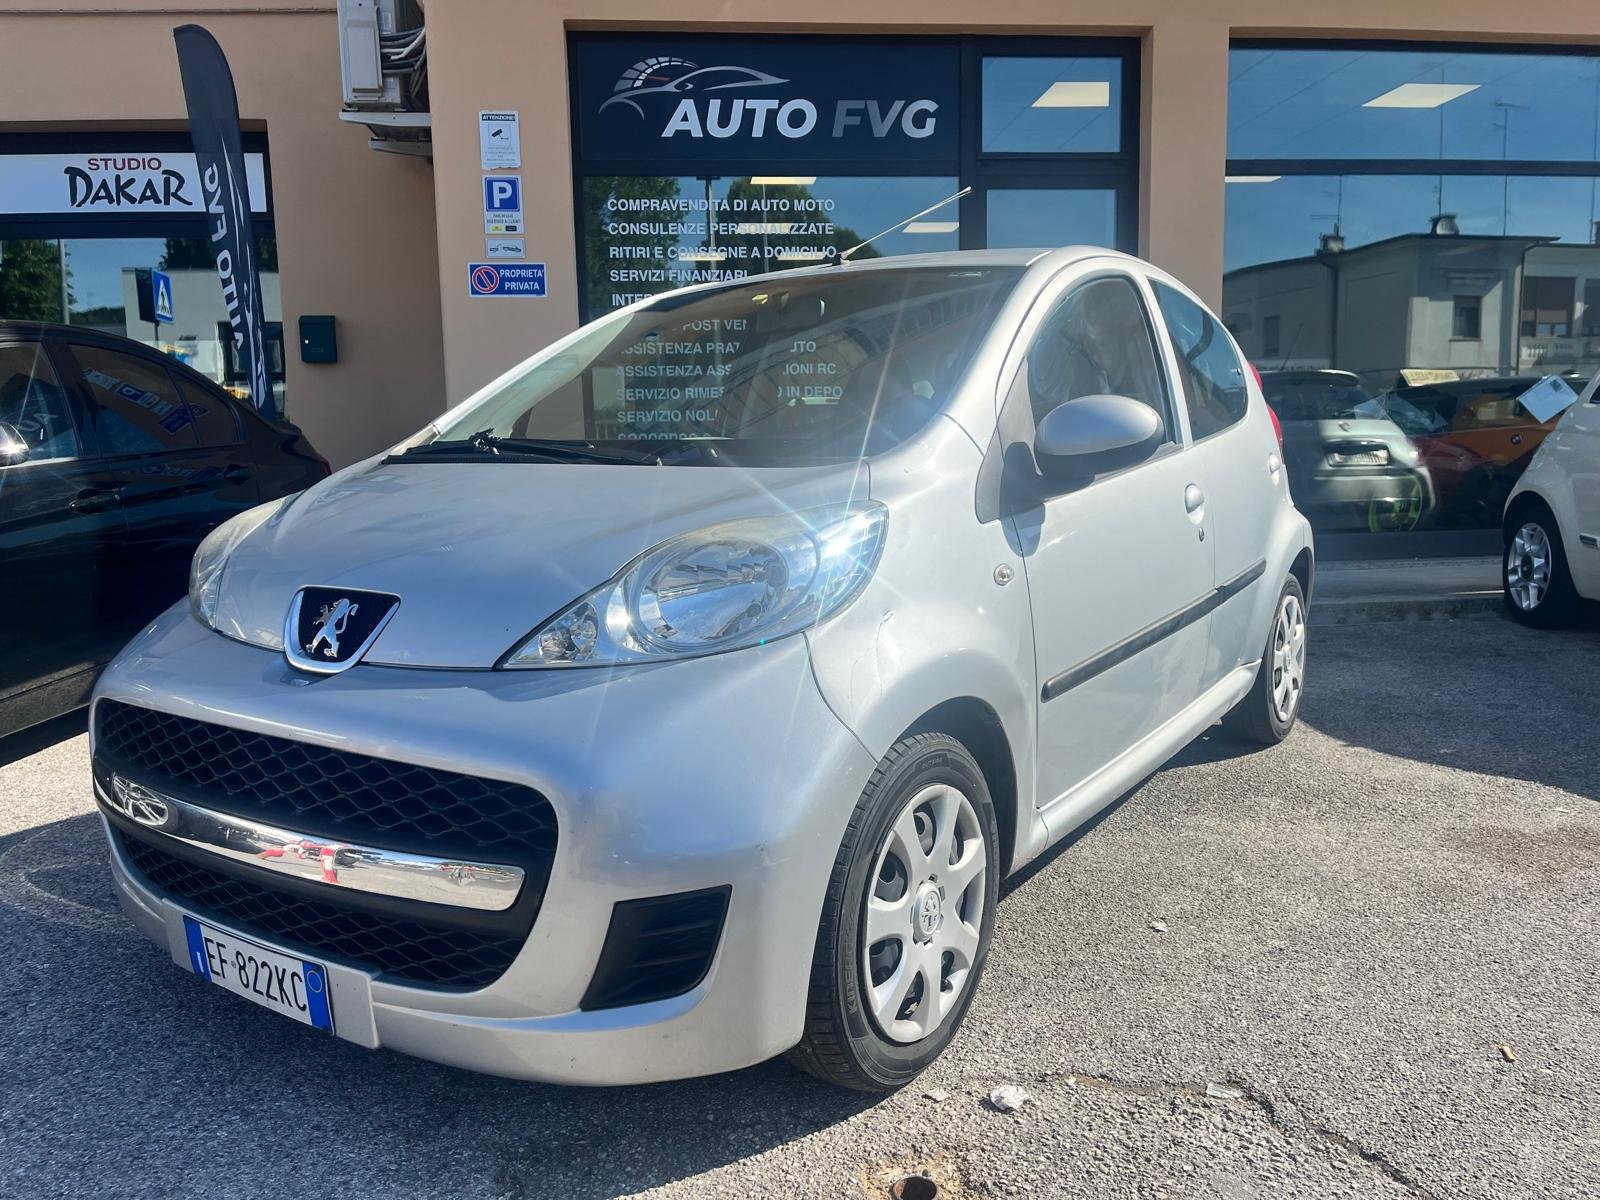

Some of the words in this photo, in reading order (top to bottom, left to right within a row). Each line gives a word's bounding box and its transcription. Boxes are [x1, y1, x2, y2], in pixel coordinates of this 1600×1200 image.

[661, 98, 818, 138] AUTO
[832, 98, 939, 138] FVG
[87, 157, 162, 171] STUDIO
[63, 166, 193, 207] DAKAR
[493, 181, 513, 208] P
[607, 199, 731, 212] COMPRAVENDITA
[733, 199, 748, 211] DI
[751, 199, 791, 212] AUTO
[793, 199, 836, 212] MOTO
[608, 223, 706, 235] CONSULENZE
[710, 223, 834, 235] PERSONALIZZATE
[609, 246, 650, 258] RITIRI
[654, 246, 664, 258] E
[667, 246, 748, 258] CONSEGNE
[751, 246, 762, 258] A
[764, 246, 837, 258] DOMICILIO
[500, 269, 544, 278] PROPRIETA'
[610, 269, 666, 282] SERVIZI
[505, 281, 540, 290] PRIVATA
[817, 363, 837, 374] RC
[616, 387, 681, 400] SERVIZIO
[786, 385, 800, 397] IN
[617, 410, 682, 423] SERVIZIO
[204, 936, 228, 979] EF
[235, 950, 308, 1012] 822KC
